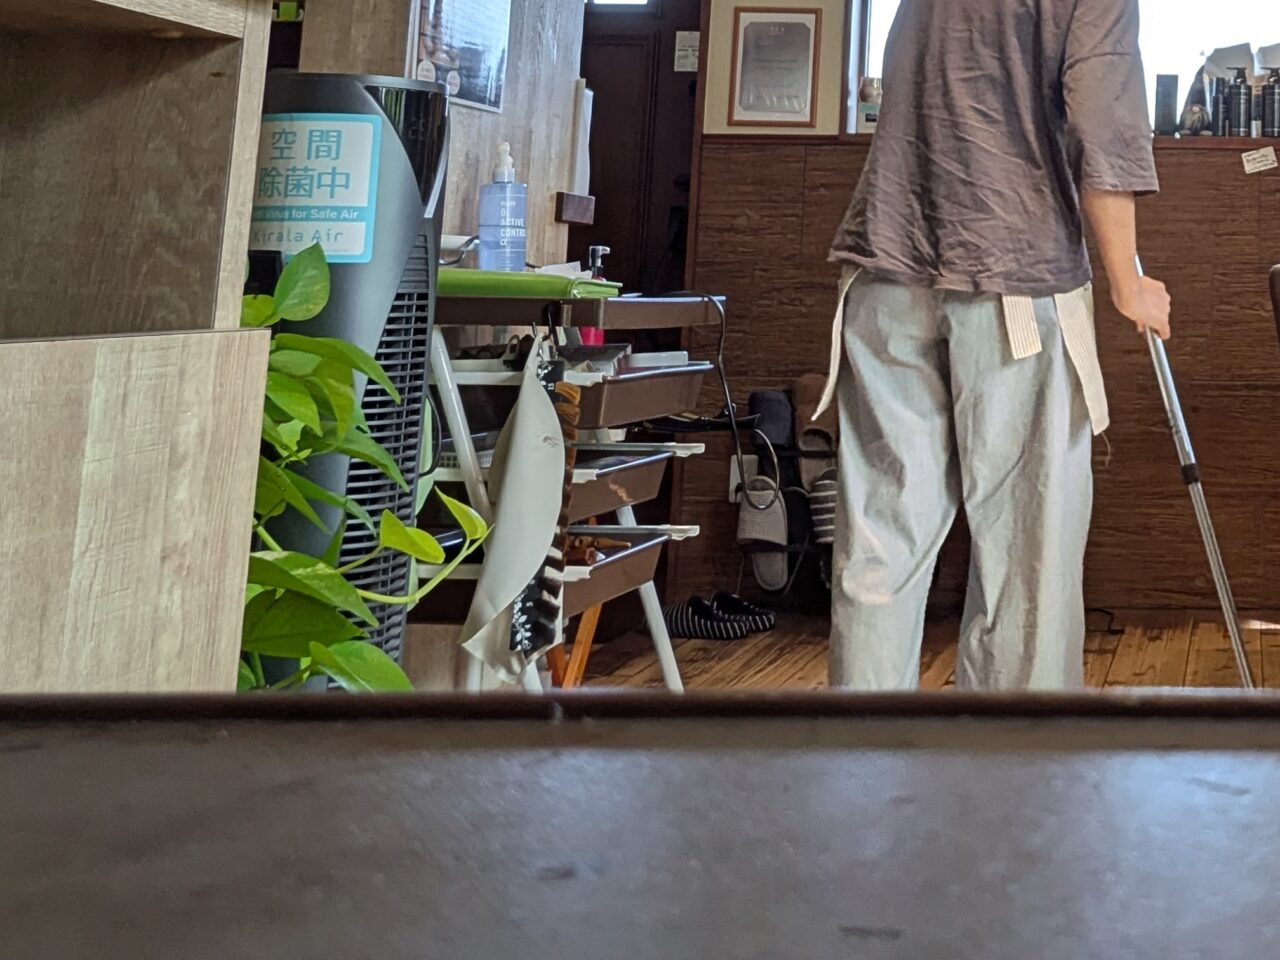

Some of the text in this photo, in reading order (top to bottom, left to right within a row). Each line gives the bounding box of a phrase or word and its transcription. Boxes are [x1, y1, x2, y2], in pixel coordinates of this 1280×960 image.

[269, 128, 343, 161] 空間
[257, 165, 351, 199] 除菌中
[292, 207, 307, 220] for
[310, 208, 337, 220] Safe
[340, 208, 359, 220] Air
[312, 228, 344, 242] Air
